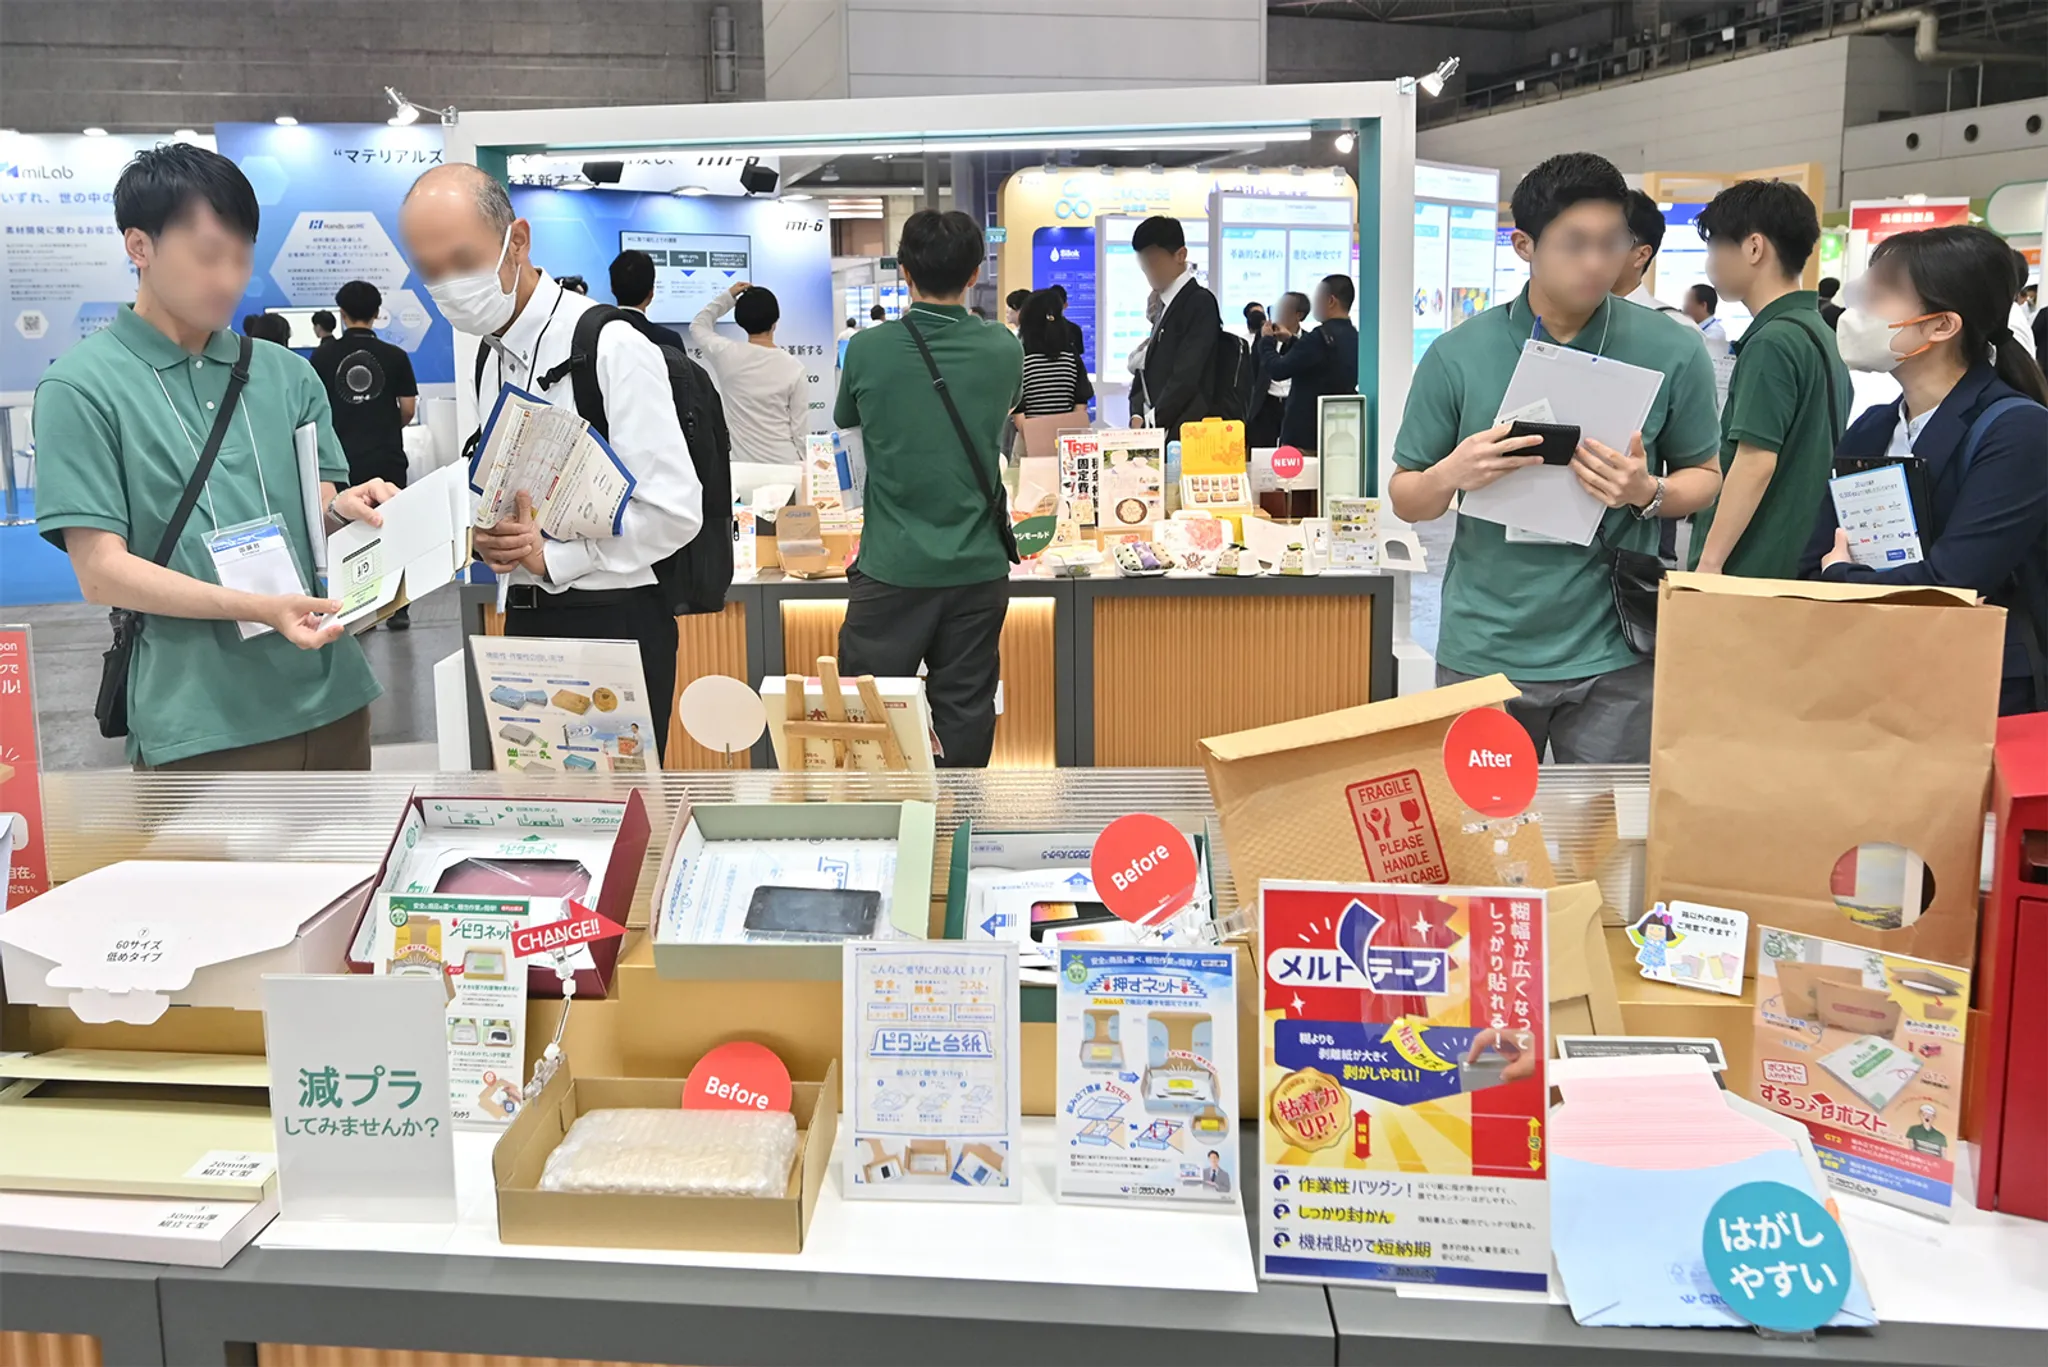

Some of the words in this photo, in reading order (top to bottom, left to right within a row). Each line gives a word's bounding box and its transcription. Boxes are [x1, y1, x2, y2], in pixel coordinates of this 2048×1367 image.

[22, 165, 74, 180] miLab
[5, 225, 120, 235] 素材開発に関わるお役立
[785, 218, 824, 232] mi-6
[1274, 458, 1300, 467] NEW!
[1077, 458, 1089, 494] 固定費
[1468, 749, 1512, 767] After
[1358, 778, 1413, 803] FRAGILE
[1379, 834, 1424, 856] PLEASE
[1111, 844, 1170, 891] Before
[1382, 851, 1430, 873] HANDLE
[1411, 865, 1443, 884] CARE
[1681, 910, 1737, 926] 箱以外の商品も
[518, 919, 600, 951] CHANGE!!
[1676, 921, 1738, 938] ご用意できます！
[116, 940, 163, 951] 60サイズ
[106, 952, 163, 962] 低めタイプ
[1113, 976, 1181, 994] 押すネット
[1487, 903, 1508, 1049] しっかり貼れる！
[1509, 902, 1532, 1049] 糊幅が広くなって
[882, 1031, 982, 1053] ピタッと台紙
[1299, 1032, 1334, 1045] 糊よりも
[1397, 1023, 1423, 1056] NEW
[1318, 1047, 1389, 1062] 剥離紙が大きく
[1343, 1065, 1420, 1083] 剥がしやすい！
[298, 1065, 422, 1110] 減プラ
[704, 1075, 769, 1110] Before
[1277, 1088, 1339, 1121] 粘着力
[284, 1116, 440, 1138] してみませんか？
[1297, 1112, 1338, 1138] UP!
[1824, 1133, 1843, 1144] GT2
[201, 1169, 253, 1178] 組立て型
[208, 1161, 260, 1169] 20mm厚
[1298, 1175, 1412, 1198] 作業性バツグン！
[1298, 1204, 1392, 1224] しっかり封かん
[157, 1220, 210, 1230] 組立て型
[1718, 1211, 1825, 1252] はがし
[1298, 1233, 1432, 1258] 機械貼りで短納期
[1730, 1260, 1839, 1300] やすい
